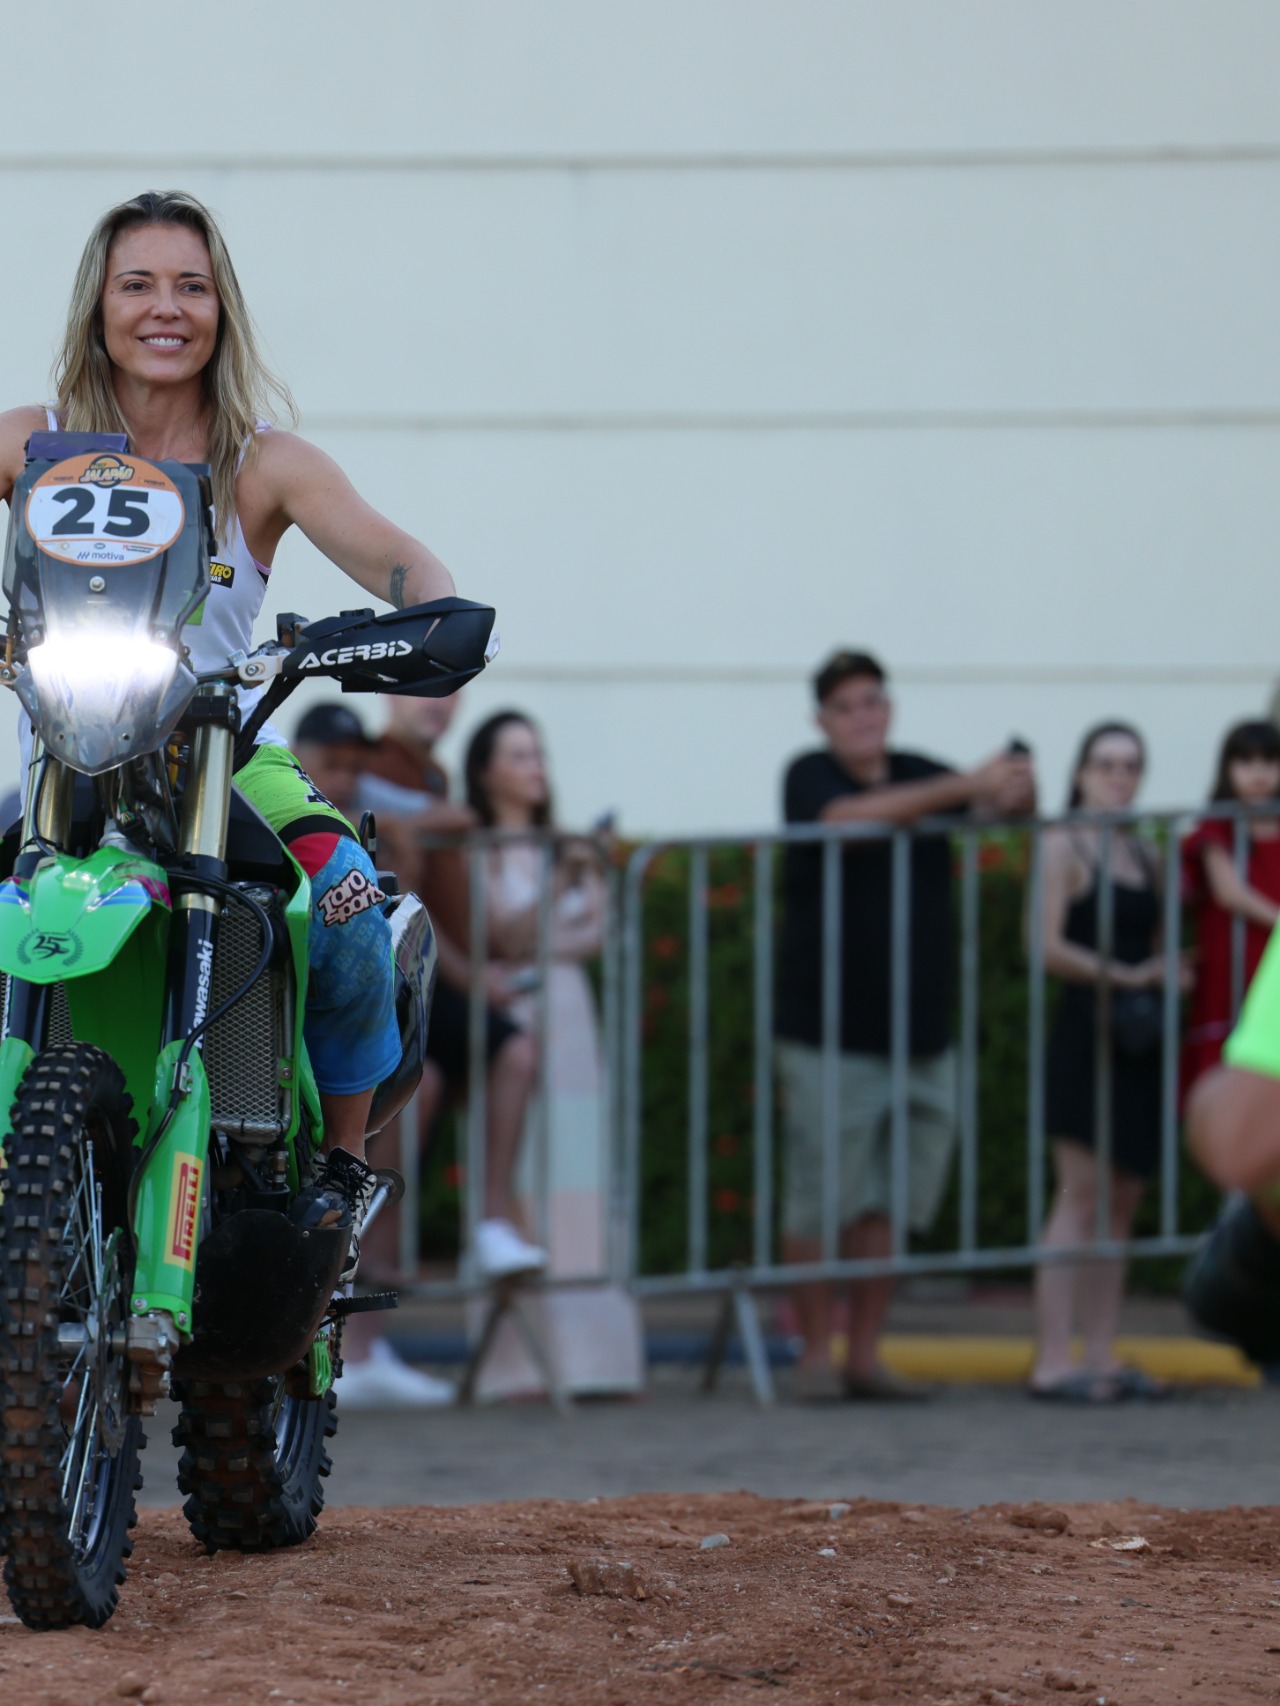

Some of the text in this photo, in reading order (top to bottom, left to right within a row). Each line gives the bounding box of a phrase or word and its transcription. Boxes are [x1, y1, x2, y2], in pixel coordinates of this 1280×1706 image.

[51, 487, 150, 537] 25
[89, 551, 125, 562] motiva
[209, 563, 232, 579] IRO
[297, 639, 414, 670] ACERBIS
[318, 870, 366, 914] Toro
[324, 882, 386, 926] sports
[172, 1162, 199, 1260] PIRELLI
